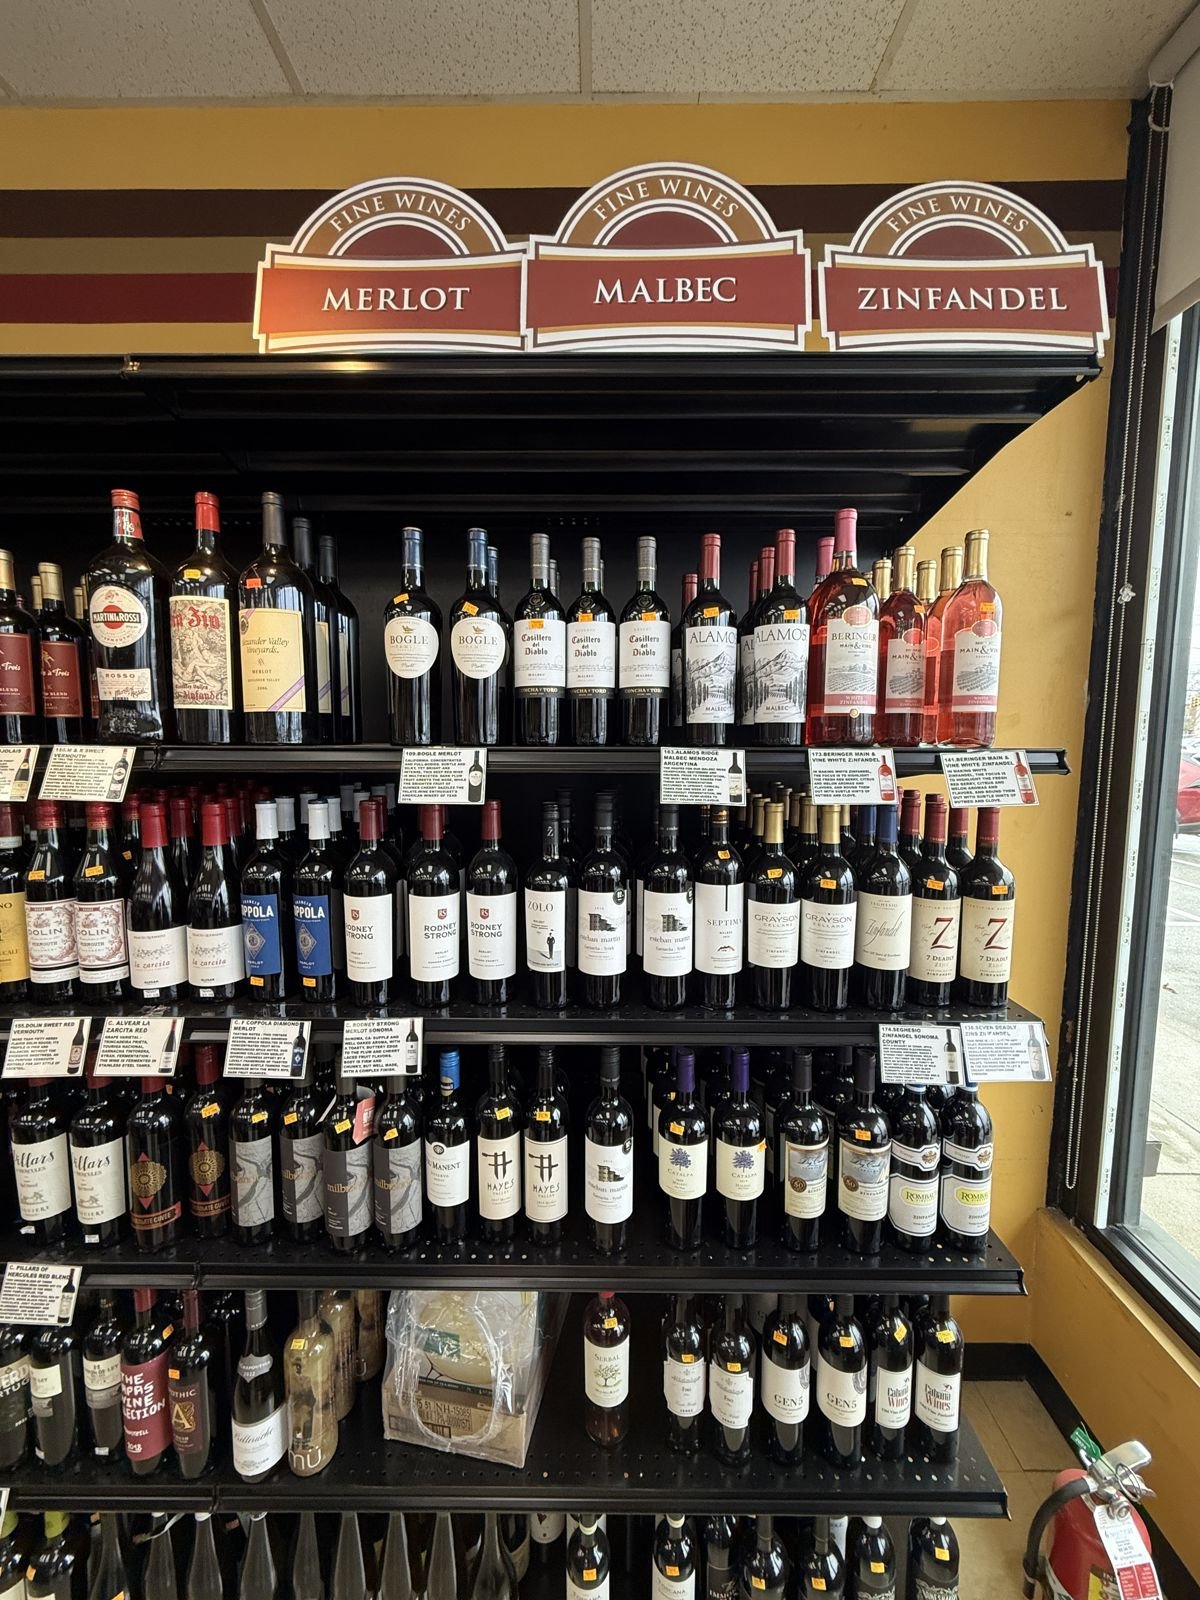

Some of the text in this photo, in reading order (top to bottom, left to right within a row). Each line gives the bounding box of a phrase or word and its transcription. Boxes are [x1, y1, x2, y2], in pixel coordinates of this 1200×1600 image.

[593, 179, 739, 221] FINE WINES
[330, 193, 471, 232] FINE WINES
[887, 195, 1029, 233] FINE WINES
[593, 277, 738, 304] MALBEC
[321, 287, 470, 312] MERLOT
[857, 287, 1068, 312] ZINFANDEL
[389, 635, 429, 645] BOGLE
[458, 635, 498, 646] BOGLE
[521, 633, 552, 642] Casillero
[571, 636, 601, 644] Casillero
[629, 635, 660, 643] Casillero
[689, 631, 737, 645] ALAMO
[755, 627, 808, 643] ALAMOS
[831, 632, 877, 642] BERINGER
[524, 648, 548, 656] Diablo
[632, 648, 656, 656] Diablo
[527, 900, 554, 913] ZOLO
[754, 914, 799, 923] GRAYSON
[805, 912, 853, 924] GRAYSON
[424, 921, 457, 932] RODNEY
[470, 921, 503, 932] RODNEY
[424, 929, 457, 940] STRONG
[471, 929, 503, 938] STRONG
[15, 1151, 55, 1169] illars
[73, 1155, 111, 1172] illars
[432, 1161, 461, 1171] MANENT
[667, 1168, 694, 1178] CATALPA
[532, 1182, 561, 1194] HAYES
[924, 1383, 951, 1401] Cabana
[773, 1393, 805, 1408] GEN5
[826, 1391, 857, 1409] GEN5
[887, 1395, 909, 1408] Wines
[925, 1392, 951, 1411] Wines
